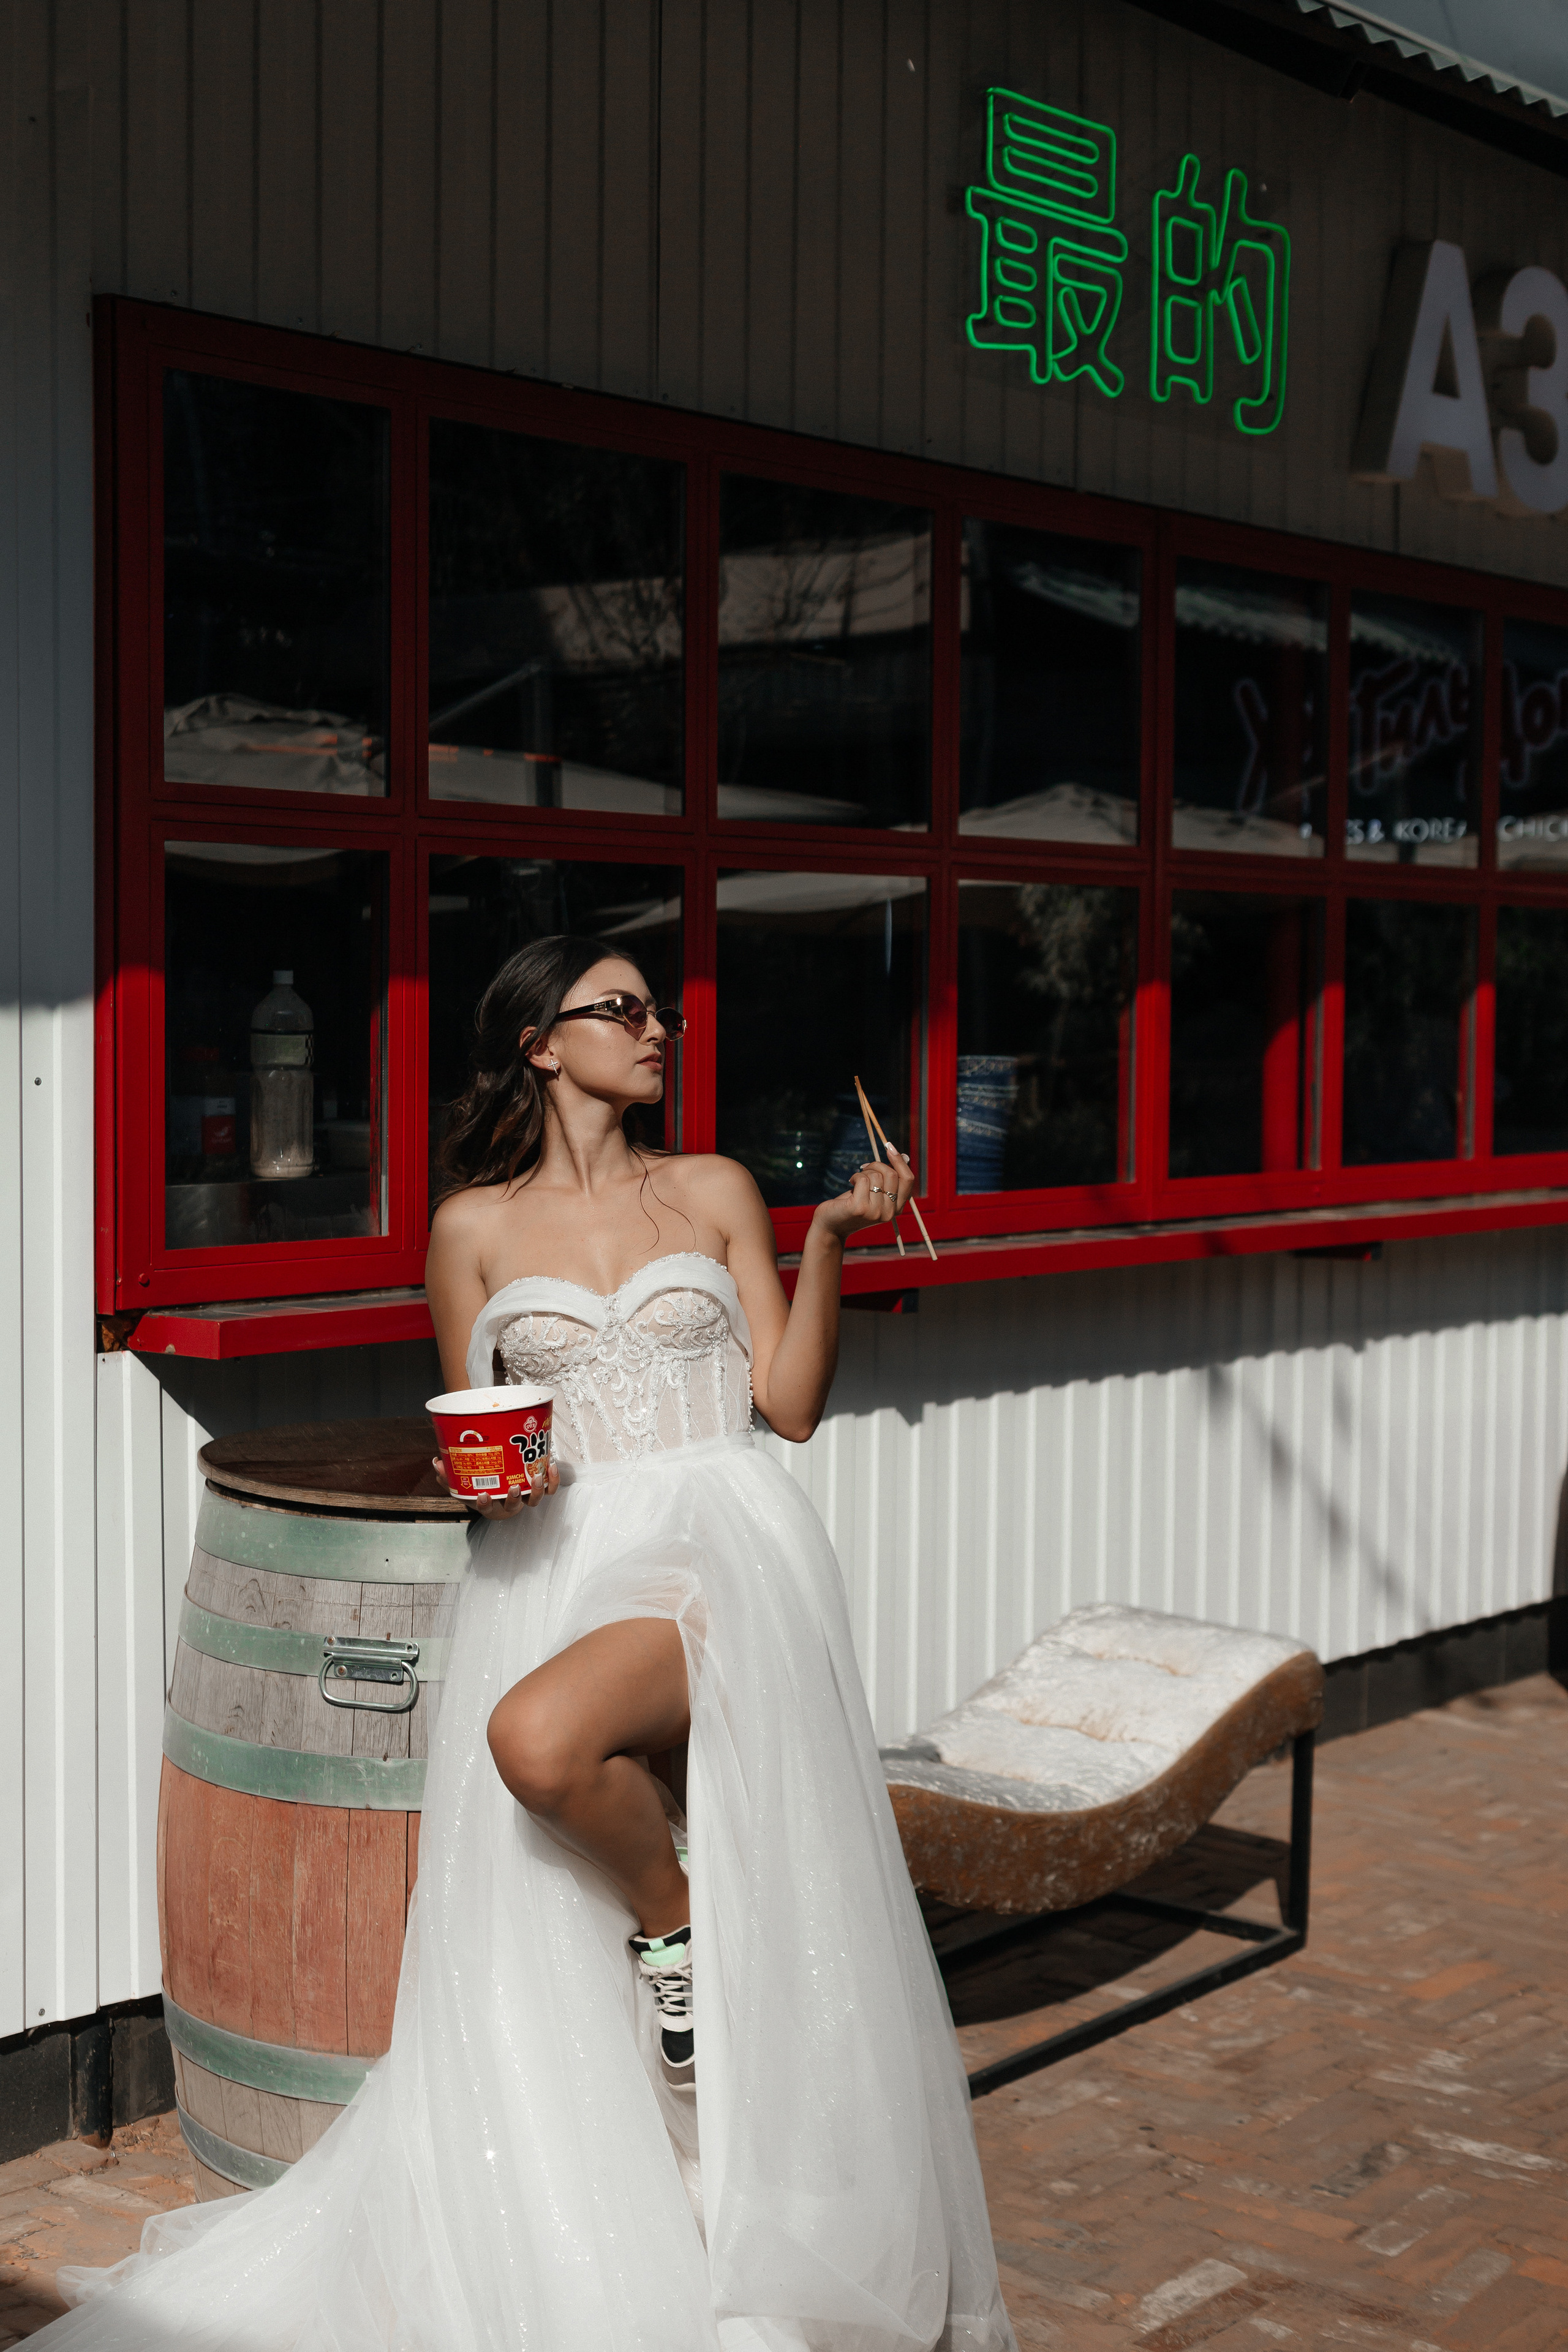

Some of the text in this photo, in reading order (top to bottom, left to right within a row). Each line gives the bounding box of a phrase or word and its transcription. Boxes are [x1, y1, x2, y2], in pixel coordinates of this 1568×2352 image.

[966, 86, 1291, 435] 最的
[1495, 815, 1568, 843] CHIC
[510, 1430, 552, 1464] 김치
